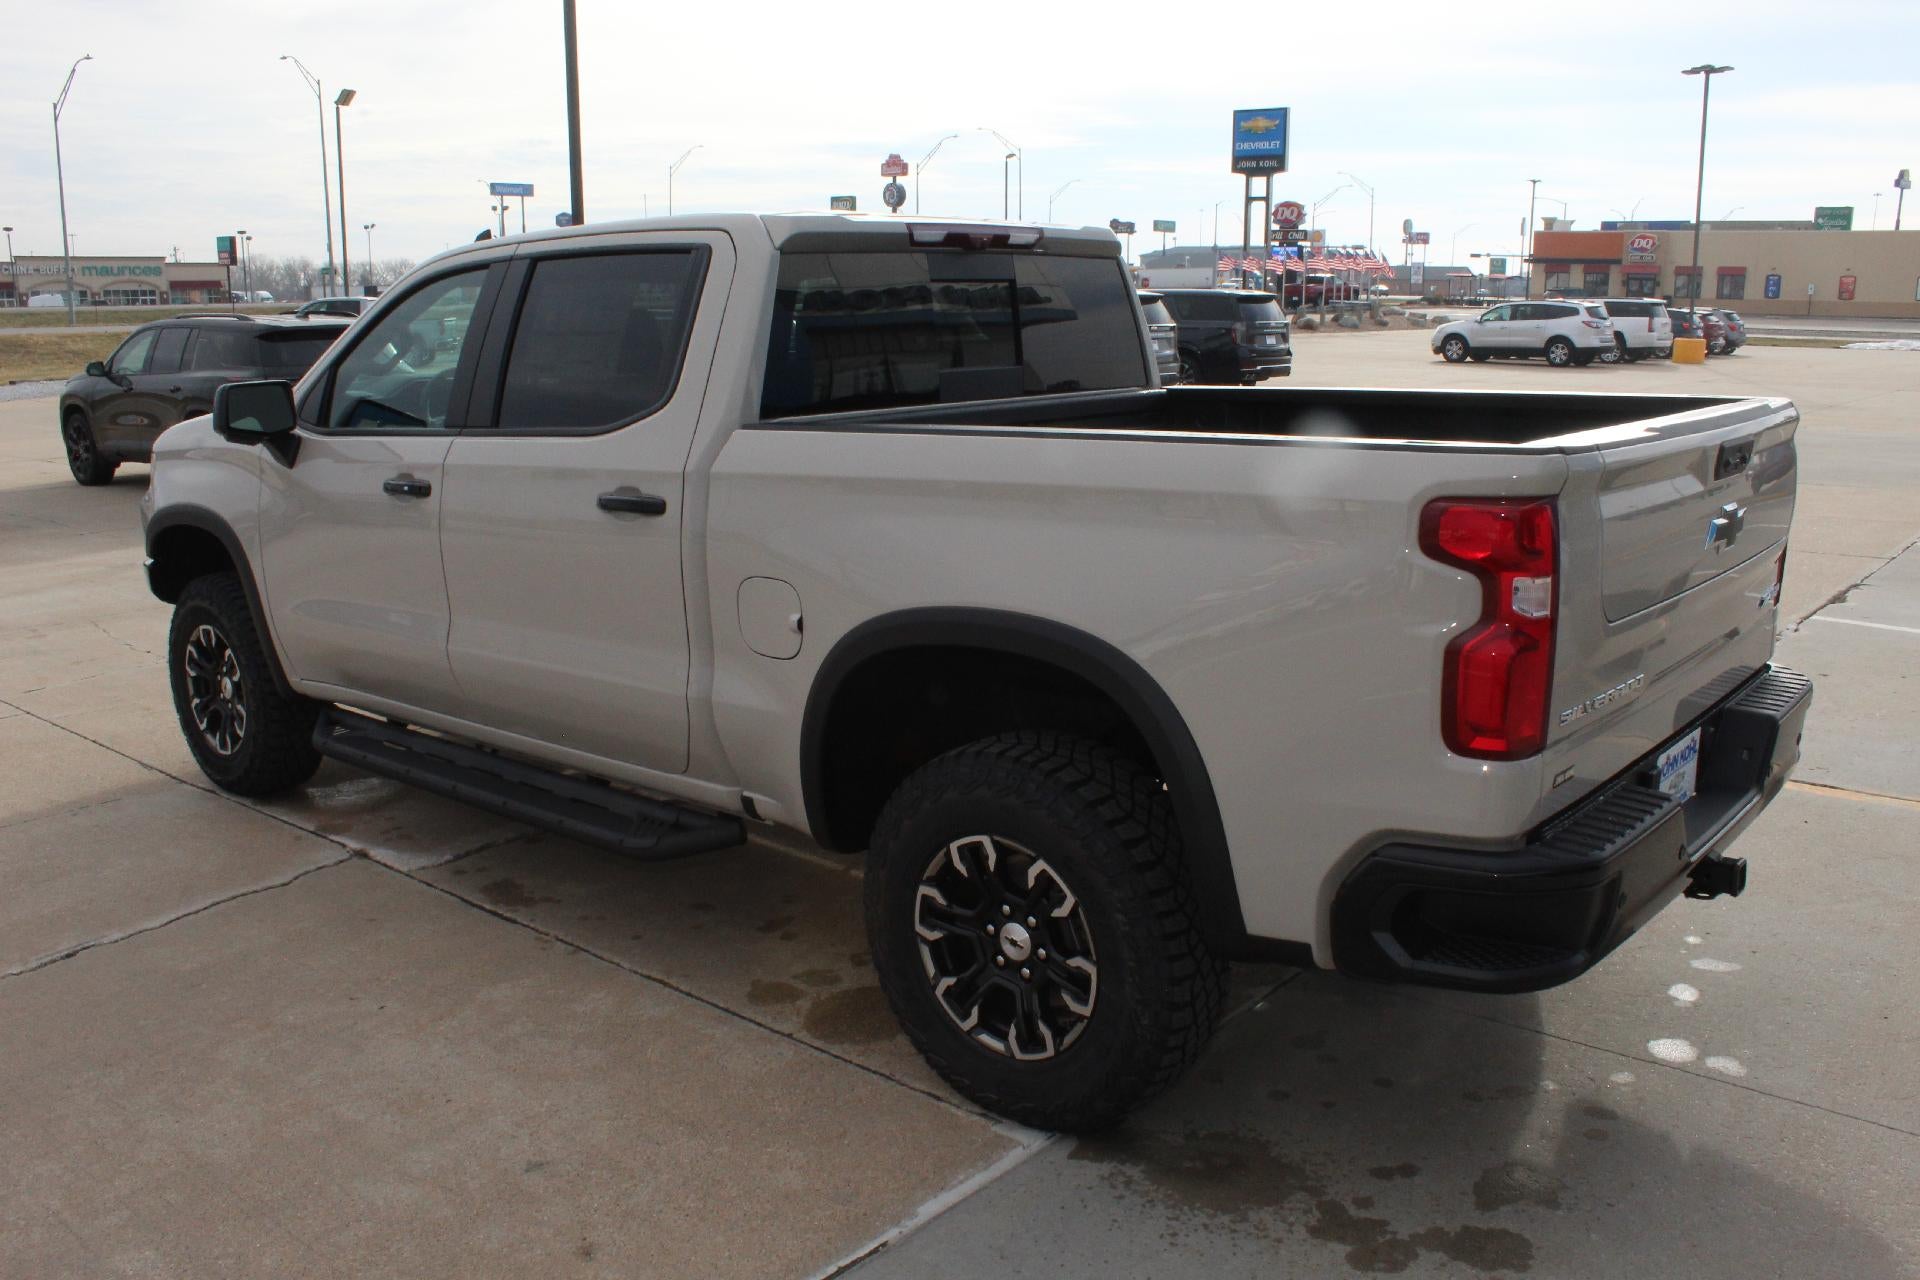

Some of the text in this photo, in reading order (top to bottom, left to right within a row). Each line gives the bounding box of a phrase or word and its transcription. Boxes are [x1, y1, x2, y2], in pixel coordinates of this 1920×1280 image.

[1236, 141, 1281, 150] CHEVROLET
[1237, 160, 1279, 168] JOHN KOHL
[1277, 207, 1298, 220] DQ
[1633, 239, 1653, 249] DQ
[81, 265, 162, 277] maurices
[1560, 673, 1645, 727] SILVERADO
